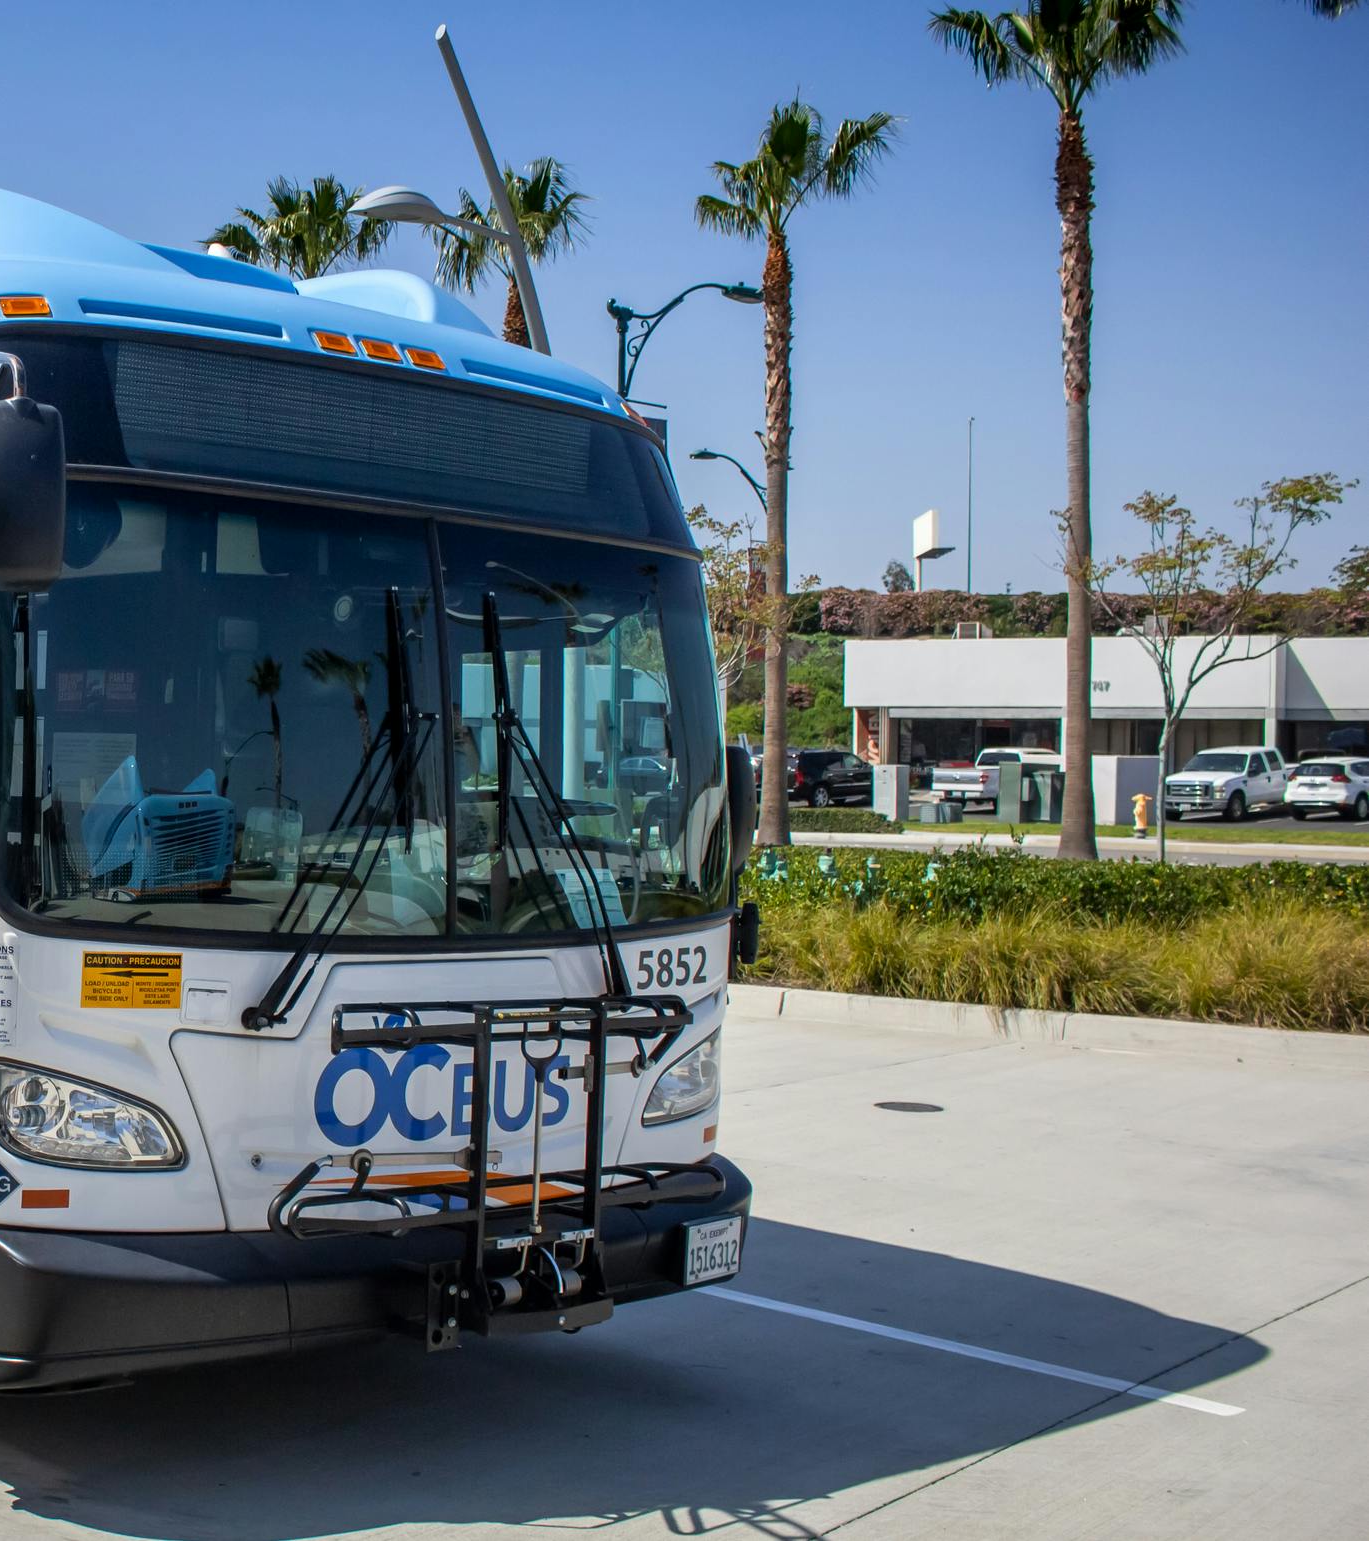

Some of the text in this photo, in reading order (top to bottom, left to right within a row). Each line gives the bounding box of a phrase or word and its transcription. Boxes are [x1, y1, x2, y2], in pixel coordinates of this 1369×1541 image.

[86, 956, 123, 965] CAUTION
[129, 957, 180, 966] PRECAUCION
[637, 945, 707, 990] 5852
[700, 1227, 729, 1240] CA EXEMPT
[689, 1239, 738, 1276] 1516312
